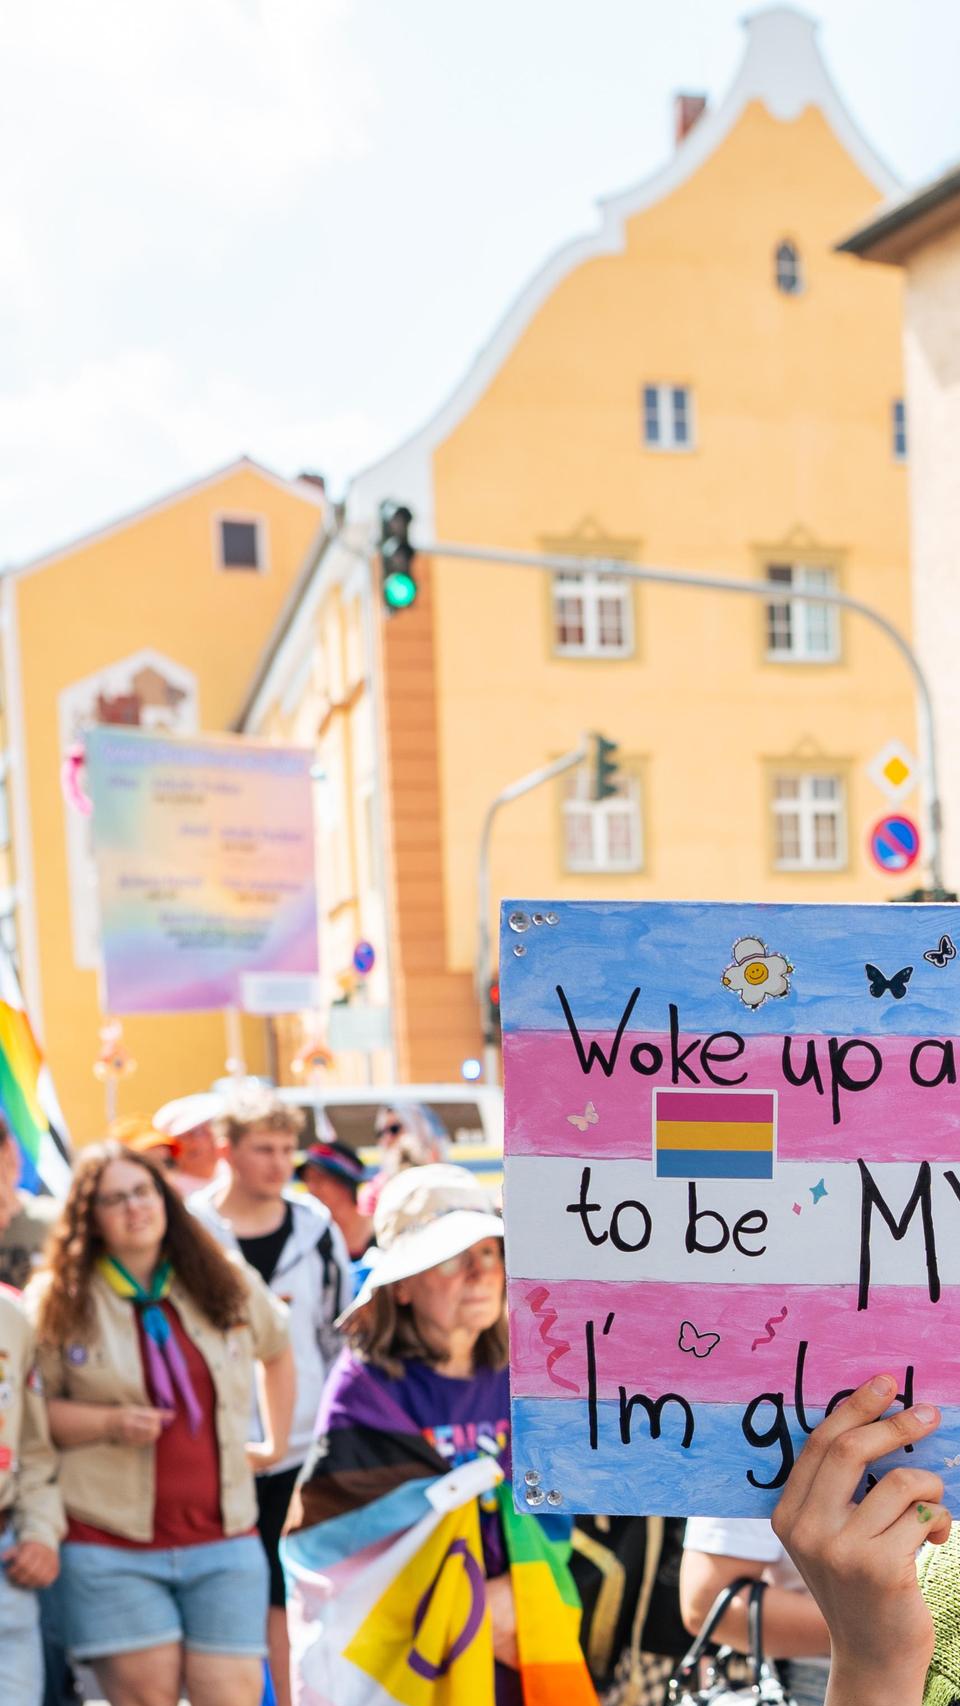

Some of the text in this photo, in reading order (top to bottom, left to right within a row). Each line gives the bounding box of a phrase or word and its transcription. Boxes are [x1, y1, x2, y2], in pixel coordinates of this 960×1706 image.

[556, 985, 748, 1086] Woke
[782, 1035, 883, 1125] up
[566, 1165, 652, 1254] to
[685, 1182, 768, 1257] be
[585, 1312, 695, 1451] I'm
